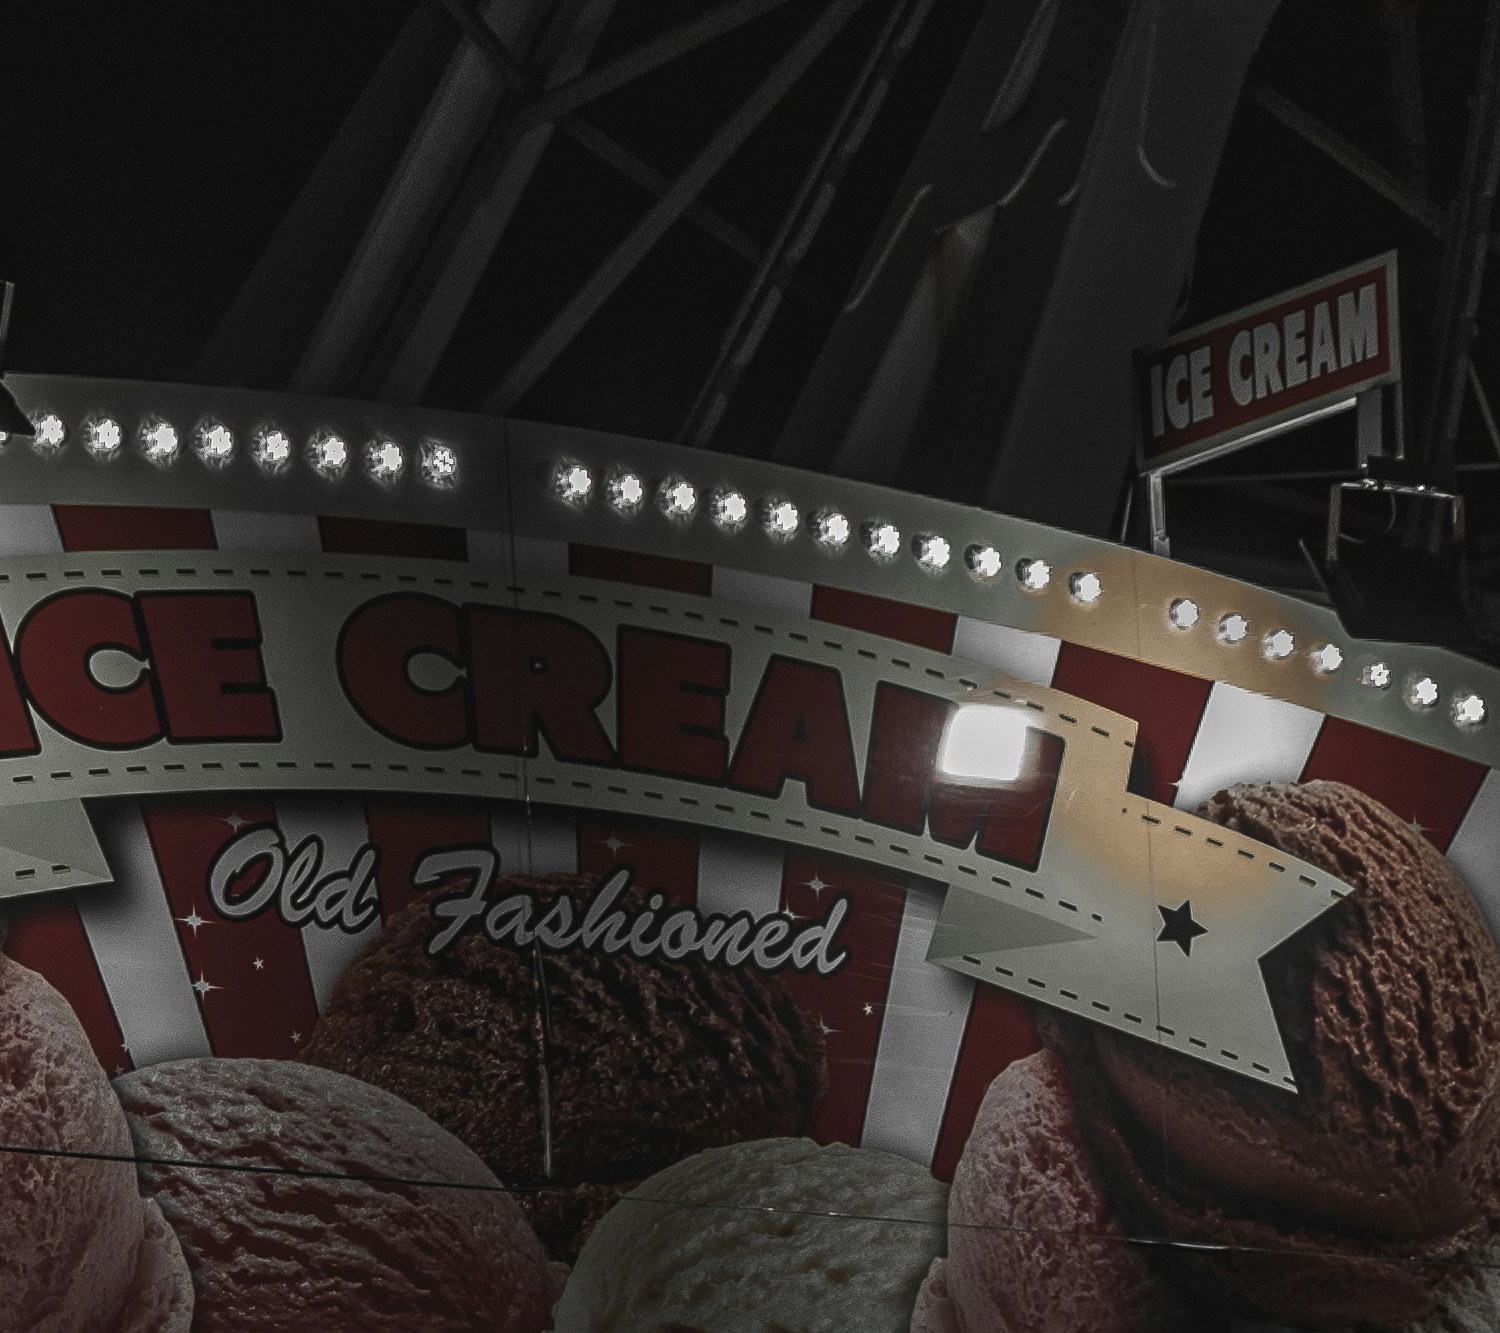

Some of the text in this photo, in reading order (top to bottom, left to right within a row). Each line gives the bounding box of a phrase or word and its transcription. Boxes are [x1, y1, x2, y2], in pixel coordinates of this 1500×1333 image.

[1149, 282, 1379, 438] ICE CREAM
[335, 593, 1066, 873] CREAM
[207, 827, 853, 978] Old Fashioned
